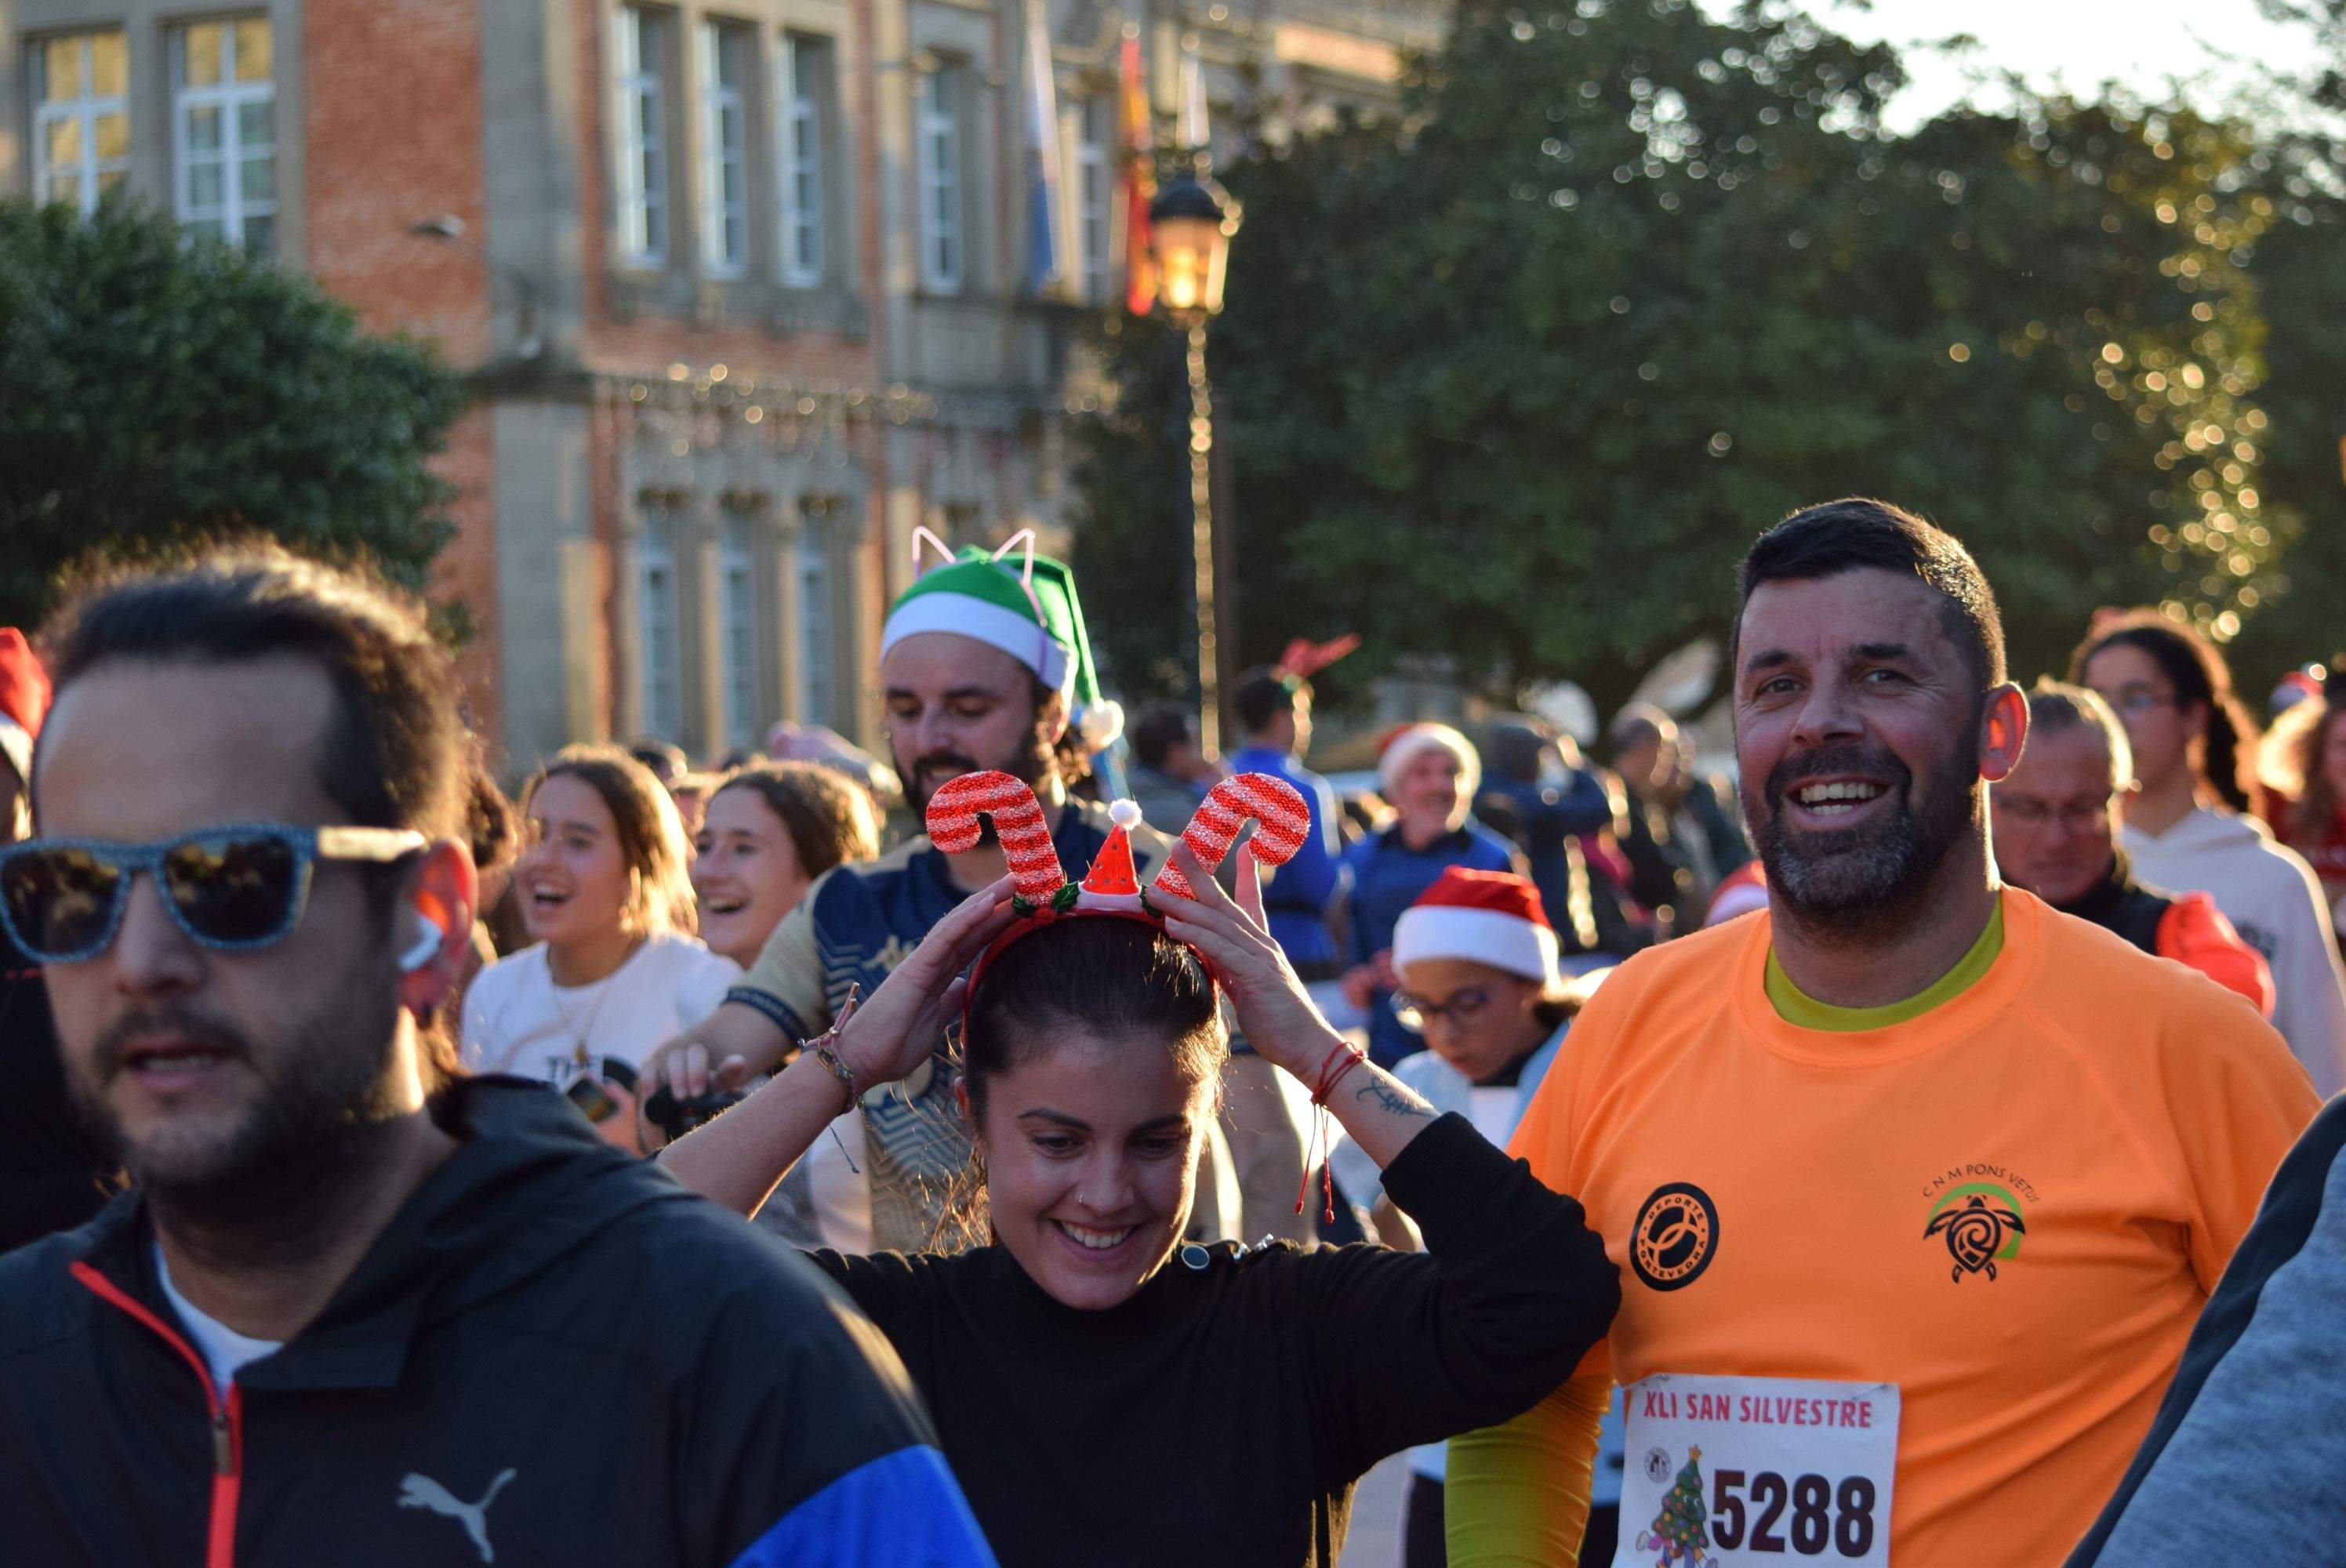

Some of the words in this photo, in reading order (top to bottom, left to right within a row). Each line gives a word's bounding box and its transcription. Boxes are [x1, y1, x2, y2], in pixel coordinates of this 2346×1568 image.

[1923, 1186, 1933, 1197] C
[1933, 1177, 1945, 1189] N
[1948, 1167, 1962, 1180] M
[1966, 1163, 2006, 1178] PONS
[2009, 1171, 2040, 1203] VETUS
[1649, 1196, 1704, 1220] DEPORTE
[1640, 1239, 1705, 1278] PONTEVEDRA
[1643, 1390, 1677, 1419] XLI
[1687, 1392, 1730, 1421] SAN
[1738, 1395, 1872, 1428] SILVESTRE
[1712, 1468, 1876, 1558] 5288
